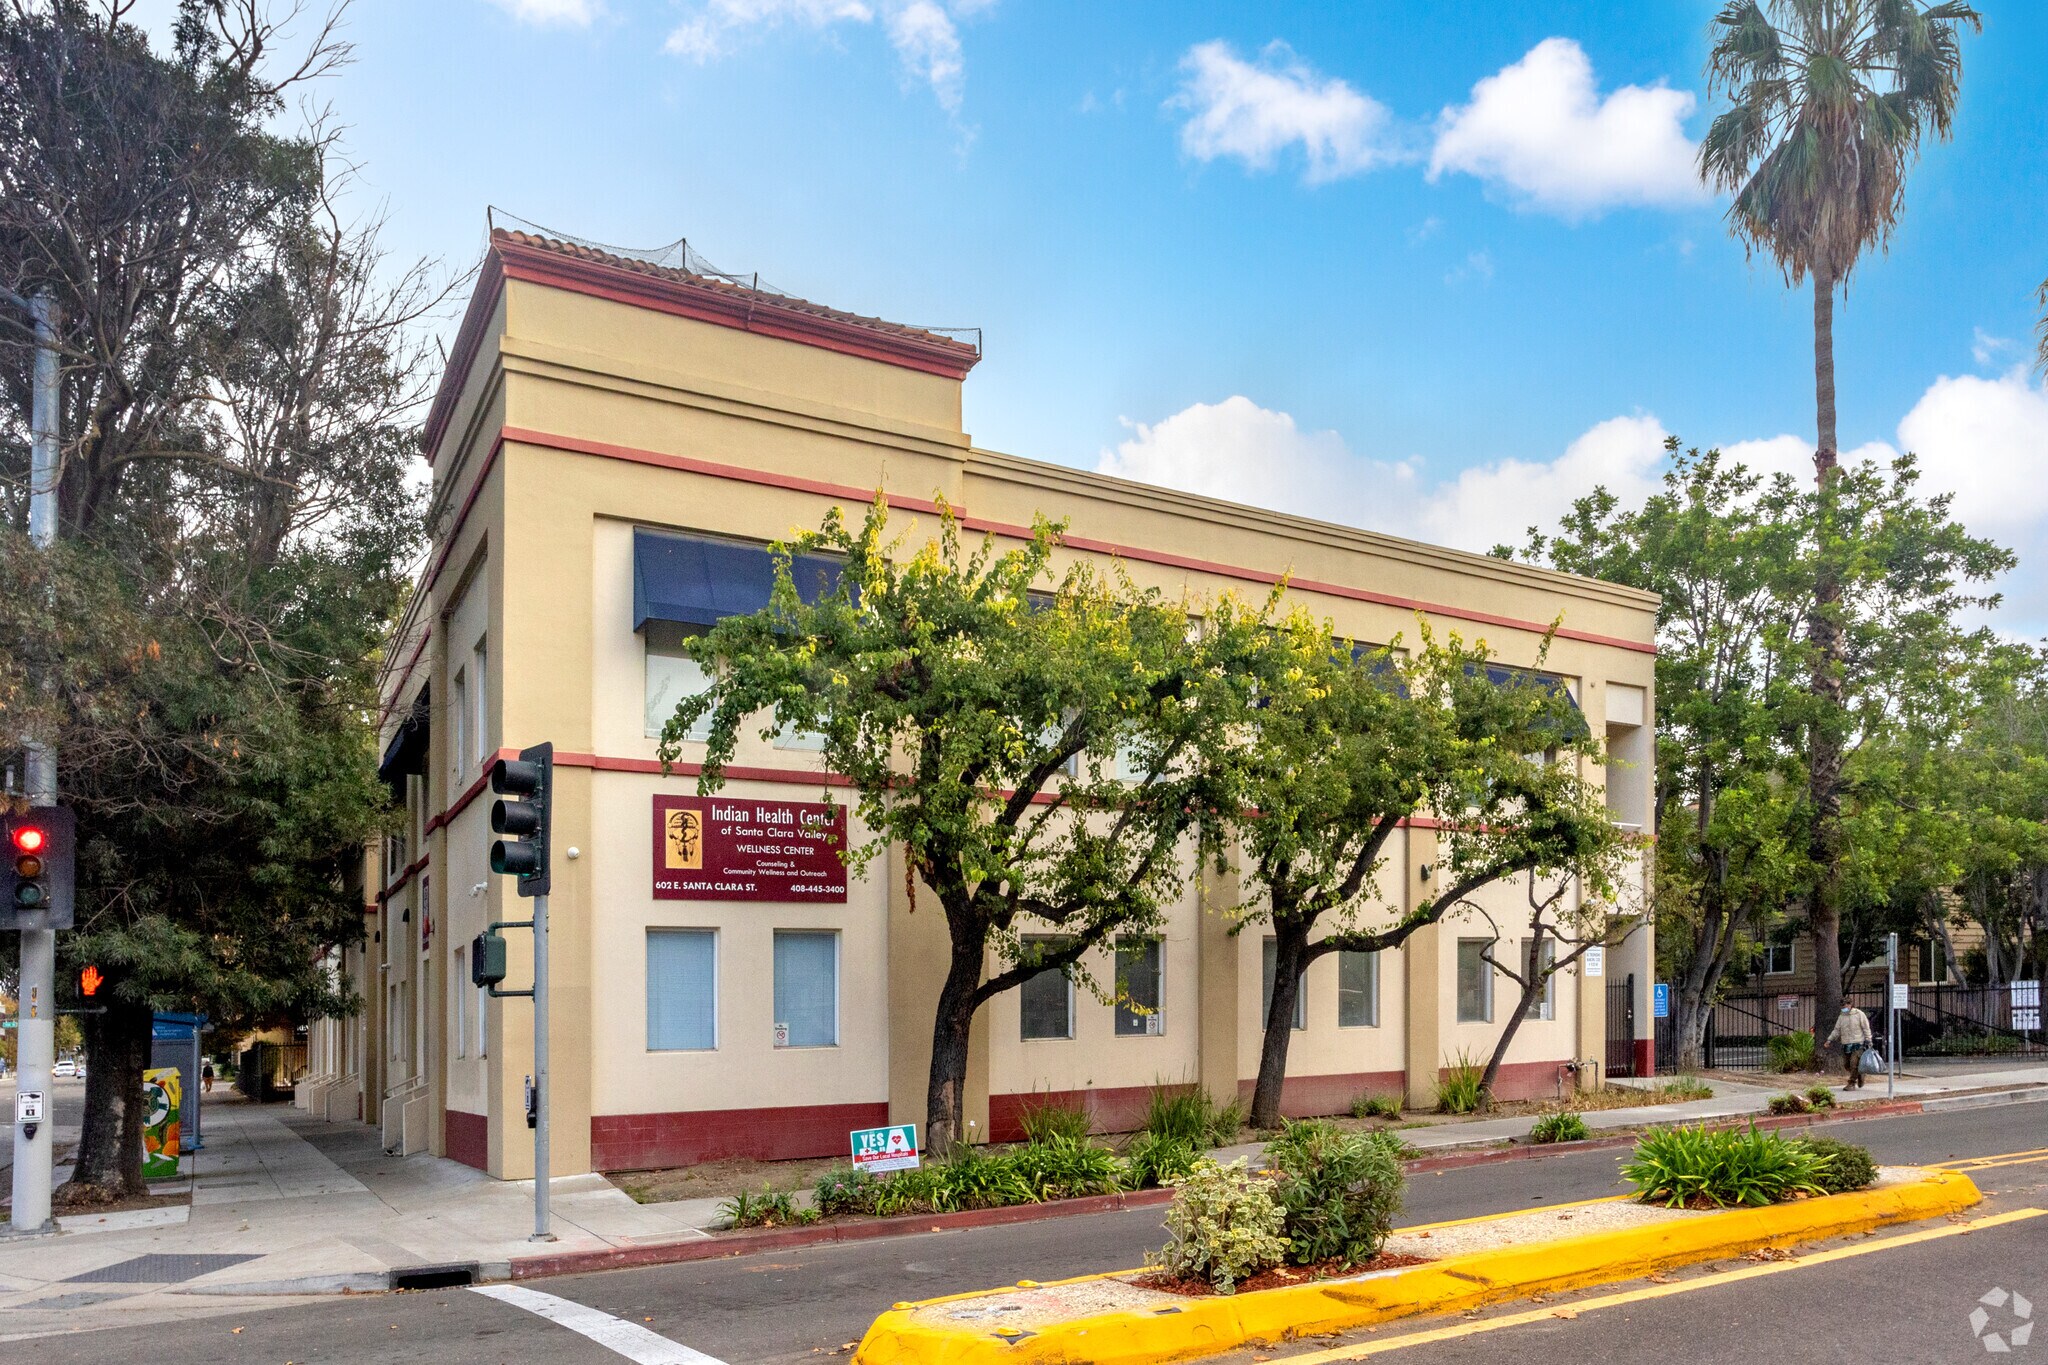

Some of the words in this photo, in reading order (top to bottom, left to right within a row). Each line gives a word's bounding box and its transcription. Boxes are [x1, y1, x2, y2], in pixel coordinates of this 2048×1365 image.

[712, 804, 749, 822] Indian
[756, 807, 793, 824] Health
[721, 826, 731, 835] of
[735, 826, 764, 837] Santa
[767, 828, 794, 838] Clara
[736, 844, 781, 855] WELLNESS
[783, 845, 815, 856] CENTER
[756, 859, 788, 869] Counseling
[789, 860, 796, 868] &
[723, 867, 756, 877] Community
[758, 868, 785, 876] Wellness
[800, 869, 827, 877] Outreach
[655, 881, 672, 890] 602
[673, 881, 682, 890] E.
[683, 881, 713, 891] SANTA
[714, 882, 744, 892] CLARA
[745, 883, 758, 892] ST.
[790, 884, 845, 894] 408-445-3400
[860, 1132, 885, 1148] YES
